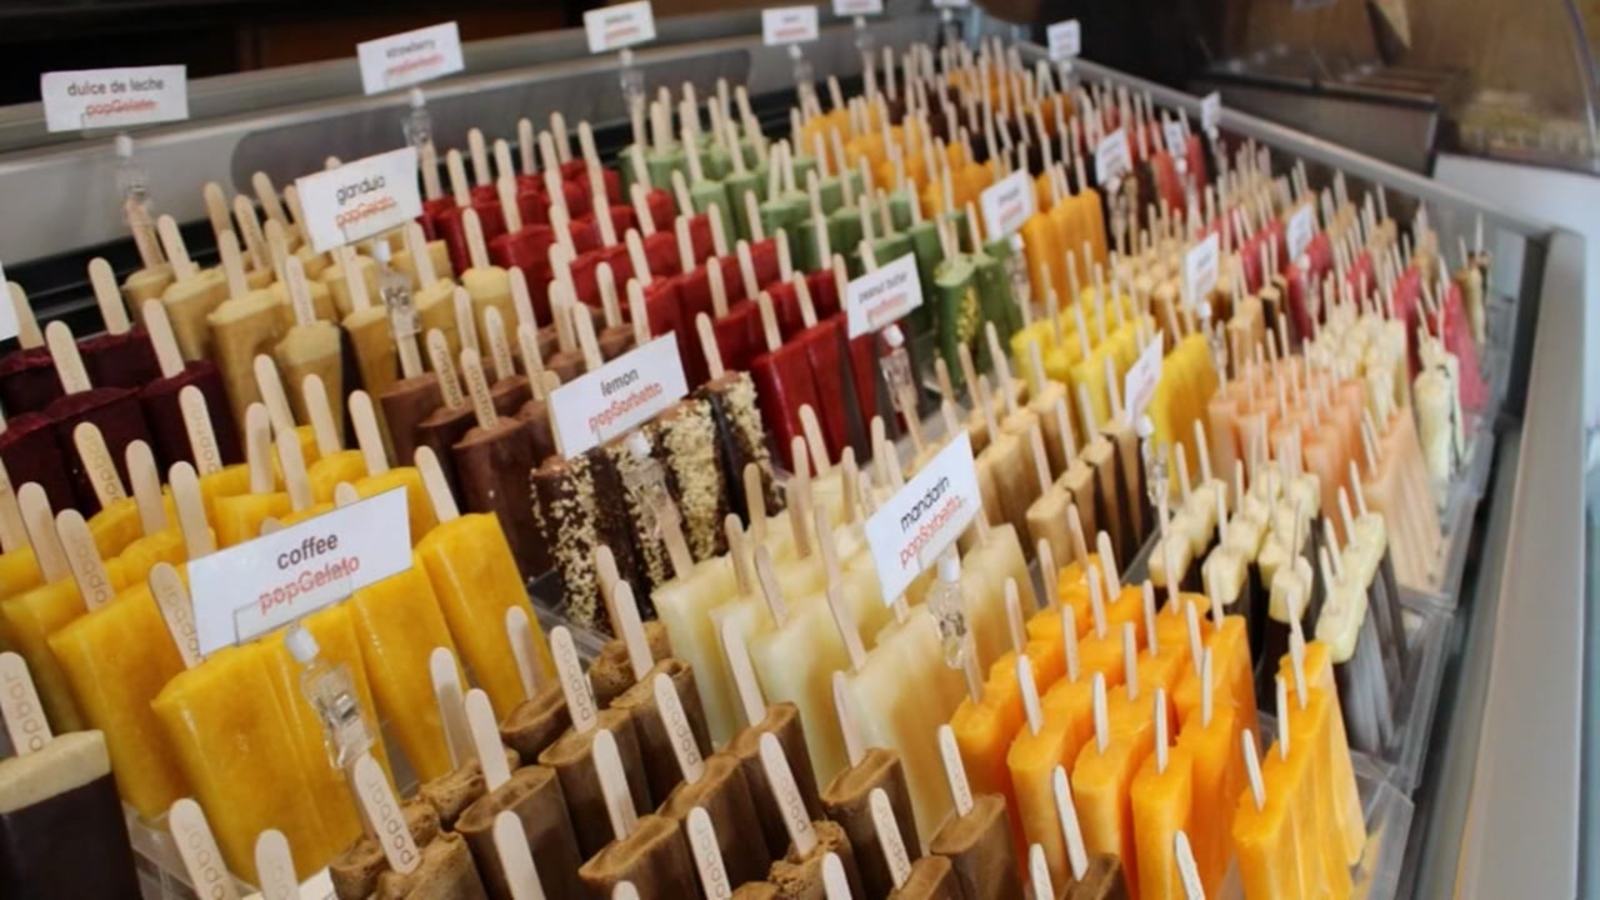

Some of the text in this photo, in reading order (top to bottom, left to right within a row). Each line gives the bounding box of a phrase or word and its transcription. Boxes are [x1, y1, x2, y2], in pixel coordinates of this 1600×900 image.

[67, 78, 164, 96] dulce de leche
[600, 368, 639, 397] lemon
[588, 382, 663, 433] popSorbetto
[900, 476, 949, 532] mandarin
[277, 534, 338, 570] coffee
[259, 556, 360, 616] popGelato
